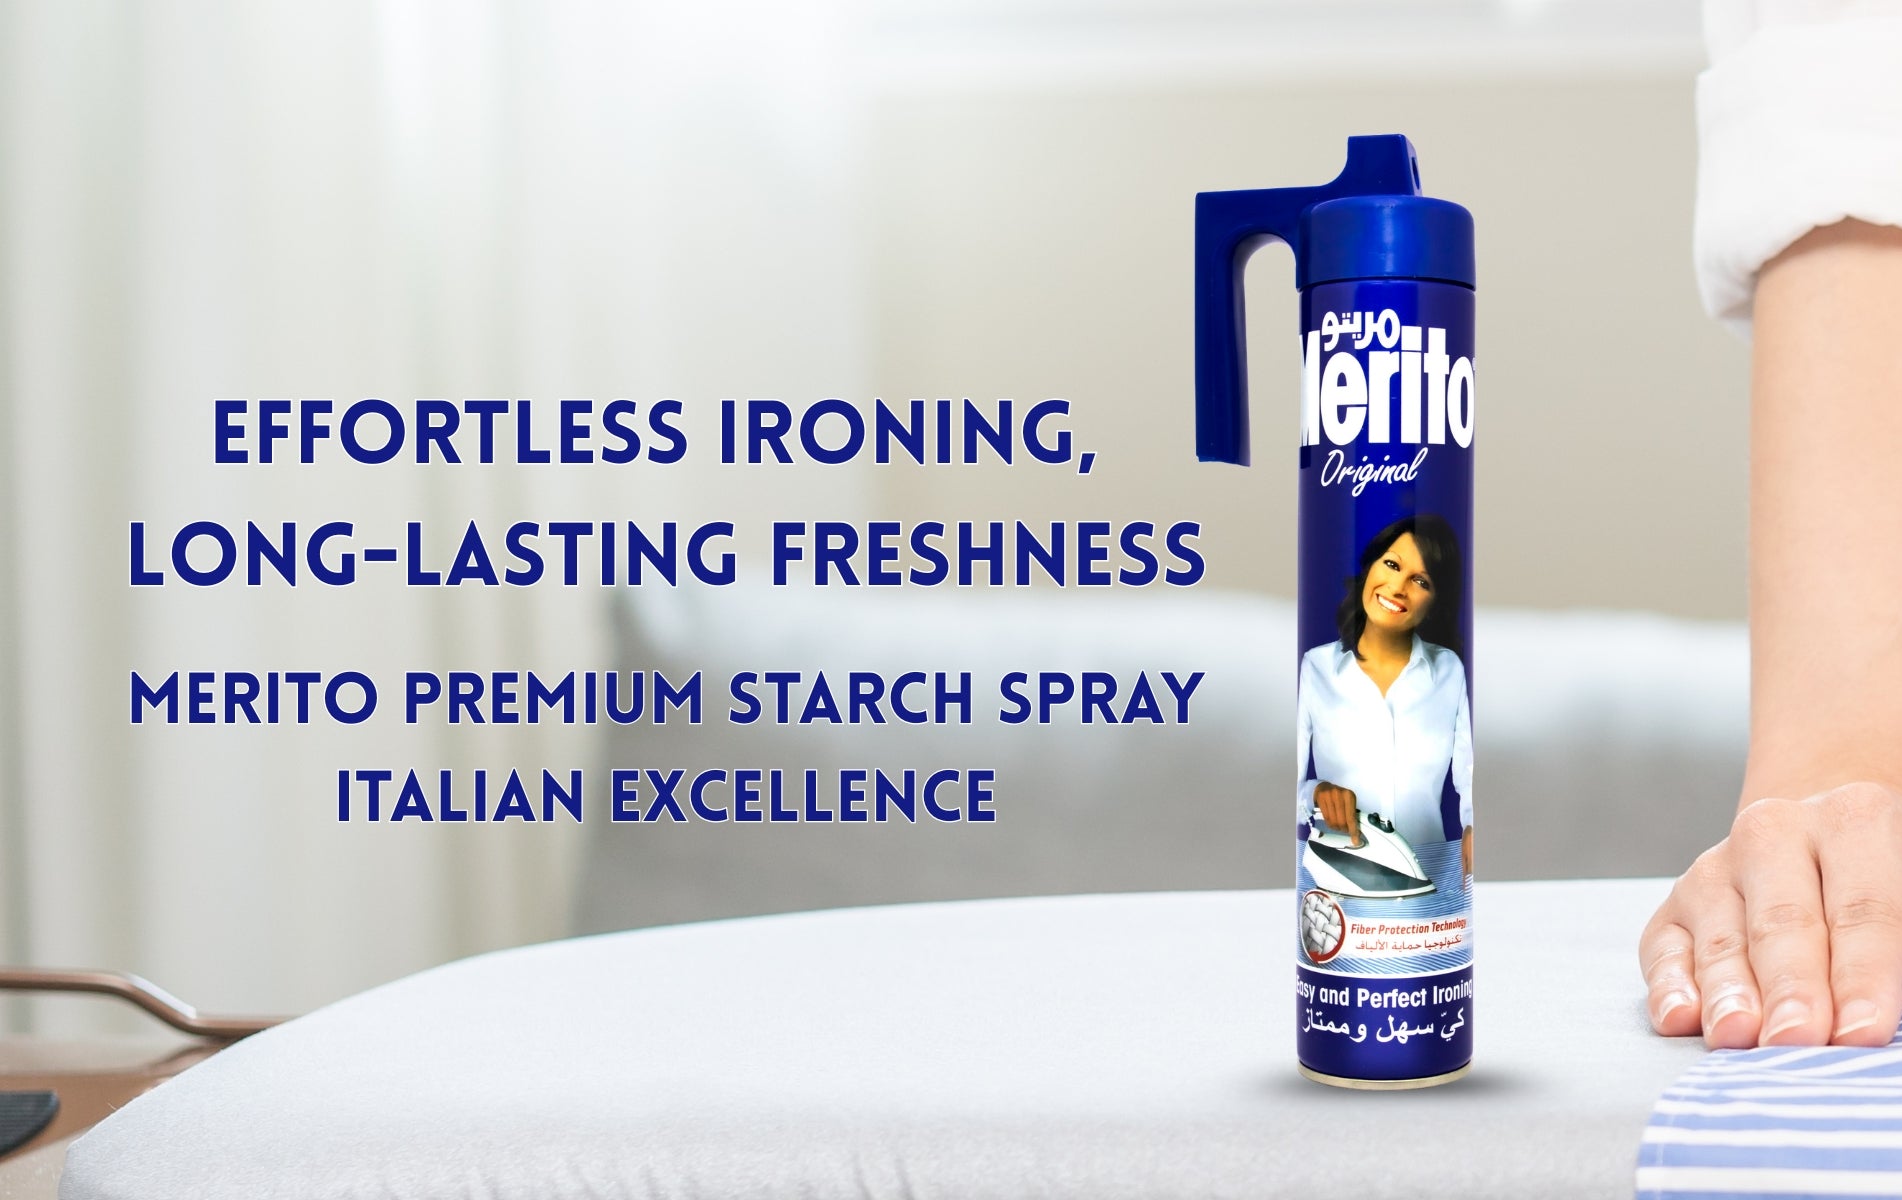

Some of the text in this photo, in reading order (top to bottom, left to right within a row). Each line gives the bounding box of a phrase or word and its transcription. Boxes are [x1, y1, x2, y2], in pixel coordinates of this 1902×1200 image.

[1322, 309, 1400, 351] مريتو
[1299, 325, 1475, 448] Merito
[1321, 447, 1428, 497] Original
[1351, 918, 1467, 935] Fiber Protection Technology
[1319, 987, 1350, 1007] and
[1357, 988, 1428, 1008] Perfect
[1433, 979, 1472, 1005] Ironing
[1376, 1014, 1434, 1044] سهل
